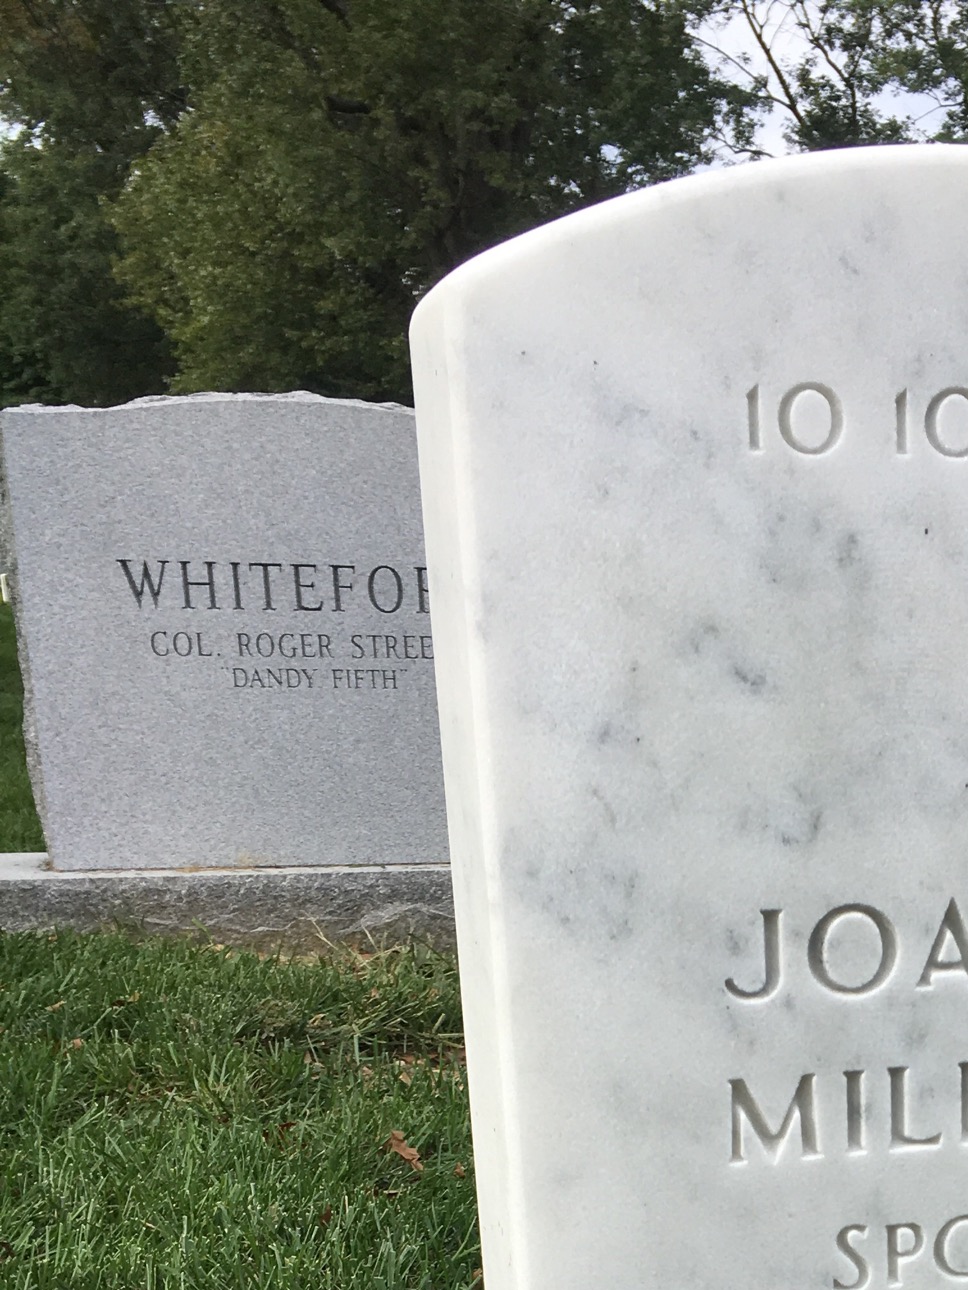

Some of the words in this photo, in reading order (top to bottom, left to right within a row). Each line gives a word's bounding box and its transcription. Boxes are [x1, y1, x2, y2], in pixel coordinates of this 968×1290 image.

[745, 381, 844, 456] 10
[151, 631, 220, 658] COL.
[236, 632, 335, 659] ROGER
